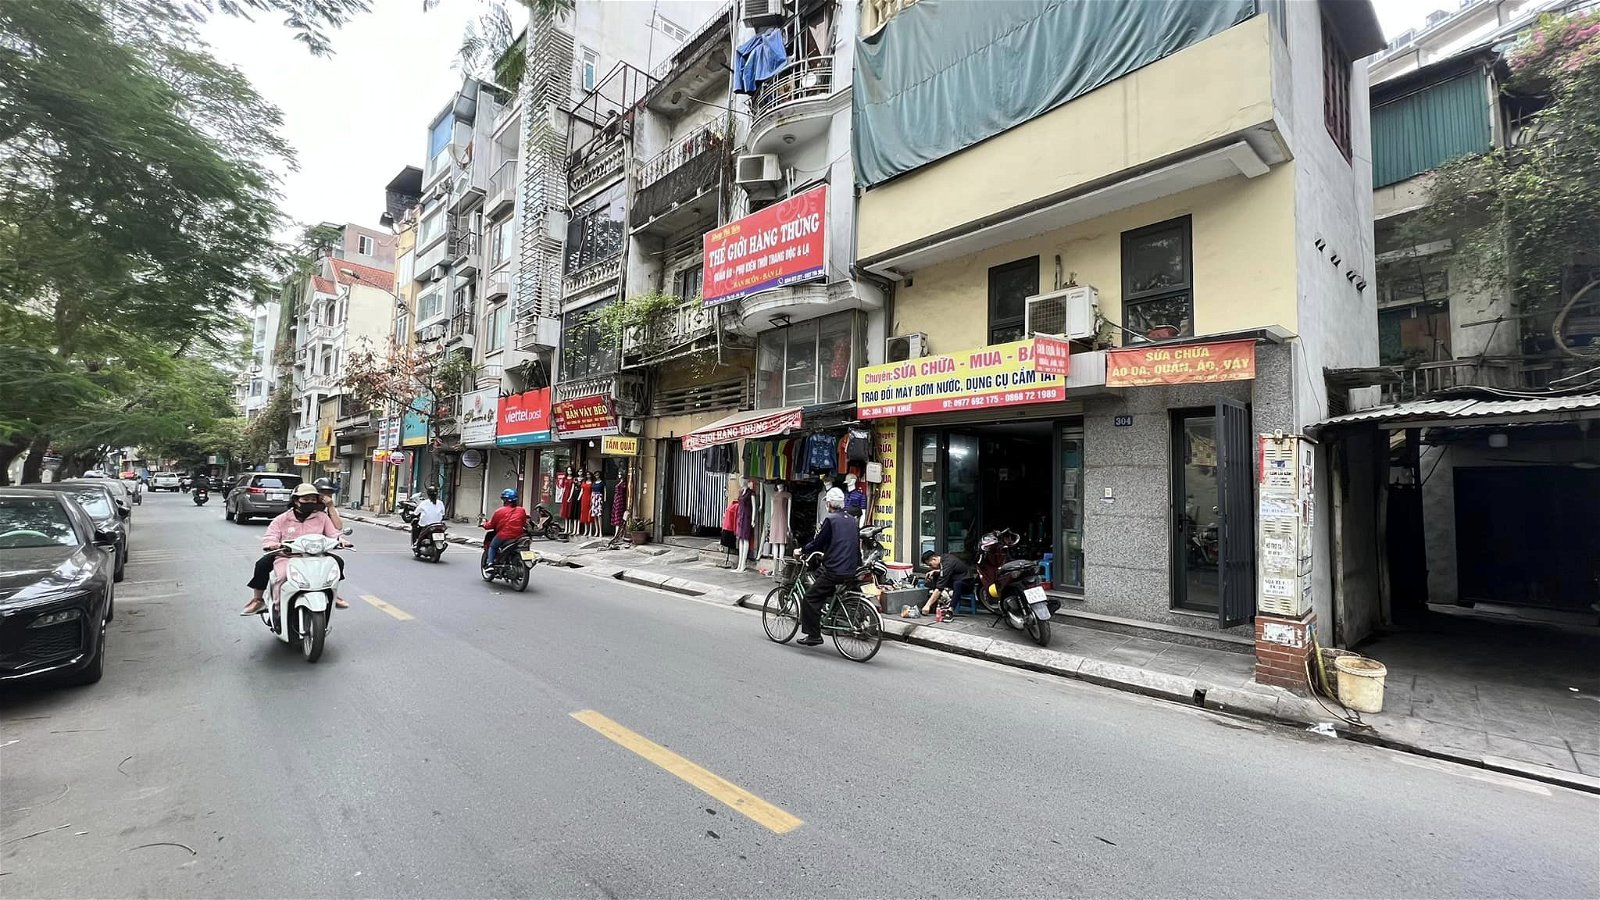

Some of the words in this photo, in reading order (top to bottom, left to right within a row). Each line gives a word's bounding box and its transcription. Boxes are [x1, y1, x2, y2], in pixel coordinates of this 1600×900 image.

[709, 238, 726, 268] THẾ
[727, 236, 747, 261] GIỚI
[749, 228, 778, 255] HÀNG
[780, 213, 820, 243] THÙNG
[1145, 349, 1170, 362] SỬA
[1175, 346, 1209, 361] CHỮA
[893, 362, 917, 380] SỬA
[921, 357, 955, 376] CHỮA
[970, 351, 1002, 369] MUA
[1223, 357, 1249, 370] VÁY
[861, 390, 879, 403] TRAO
[881, 385, 894, 400] ĐỔI
[895, 385, 913, 399] MÁY
[915, 383, 934, 396] BƠM
[966, 375, 992, 393] DỤNG
[995, 373, 1008, 389] CỤ
[1012, 366, 1036, 384] CẦM
[954, 397, 969, 407] 0977
[971, 396, 984, 405] 692
[986, 394, 999, 404] 175
[1025, 391, 1035, 400] 72
[1038, 389, 1057, 399] 1989
[505, 409, 528, 424] viettel
[528, 409, 541, 424] post
[565, 407, 579, 419] BÁN
[580, 404, 593, 417] VÁY
[1116, 417, 1131, 426] 304
